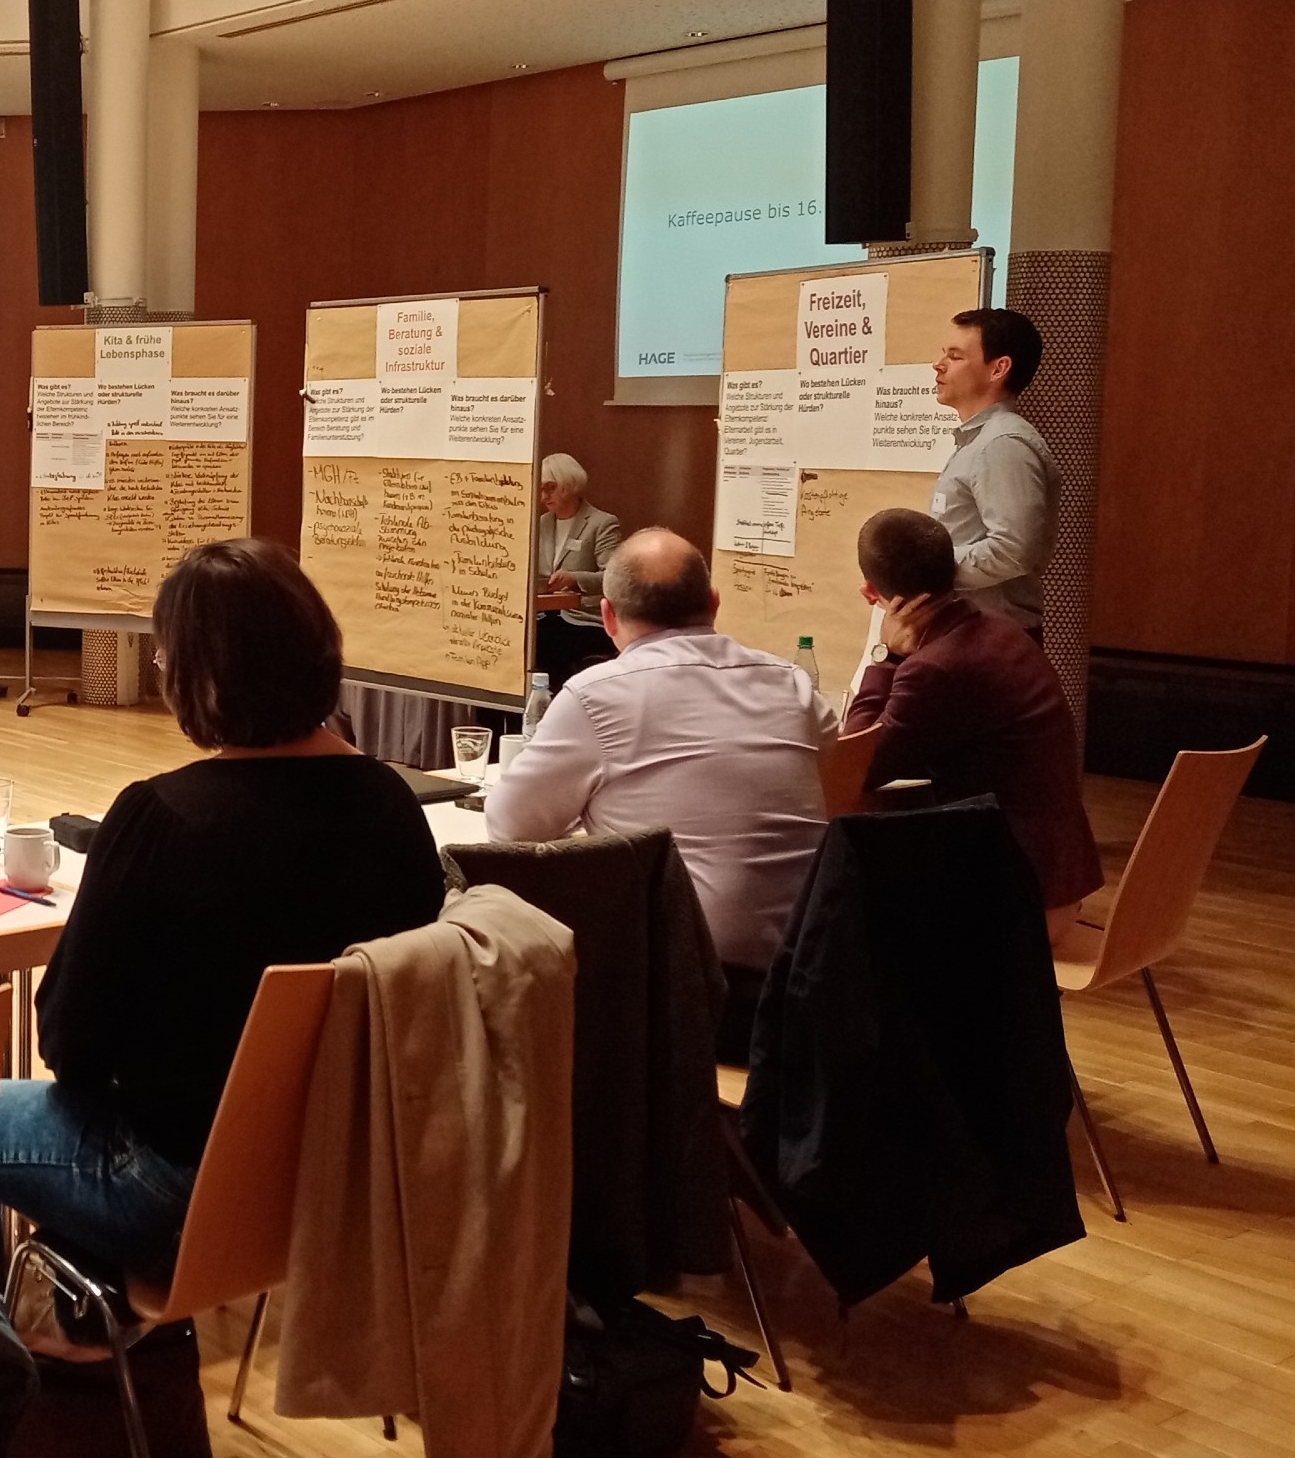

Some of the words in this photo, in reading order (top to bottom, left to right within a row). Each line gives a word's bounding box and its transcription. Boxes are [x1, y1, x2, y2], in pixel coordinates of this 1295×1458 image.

[668, 208, 762, 228] Kaffeepause
[767, 203, 791, 219] bis
[797, 200, 823, 216] 16.
[809, 289, 866, 312] Freizeit,
[397, 310, 435, 323] Familie,
[388, 328, 433, 340] Beratung
[436, 325, 443, 337] &
[804, 318, 857, 339] Vereine
[862, 316, 873, 336] &
[104, 335, 123, 345] Kita
[125, 335, 133, 345] &
[135, 335, 162, 344] frühe
[100, 349, 165, 360] Lebensphase
[398, 343, 432, 356] soziale
[639, 352, 676, 365] HAGE
[810, 346, 868, 367] Quartier
[385, 360, 446, 372] Infrastruktur
[800, 380, 810, 388] Wo
[811, 378, 840, 387] bestehen
[841, 378, 866, 387] Lücken
[419, 386, 442, 394] Lücken
[876, 386, 891, 396] Was
[892, 386, 920, 396] braucht
[921, 387, 930, 395] es
[450, 394, 464, 402] Was
[465, 394, 490, 402] braucht
[499, 394, 527, 403] darüber
[799, 392, 813, 401] oder
[814, 391, 851, 400] strukturelle
[450, 404, 475, 412] hinaus?
[874, 399, 903, 409] hinaus?
[874, 412, 899, 421] Welche
[899, 412, 933, 422] konkreten
[873, 425, 895, 436] punkte
[896, 425, 917, 435] sehen
[919, 425, 930, 435] Sie
[931, 425, 942, 435] für
